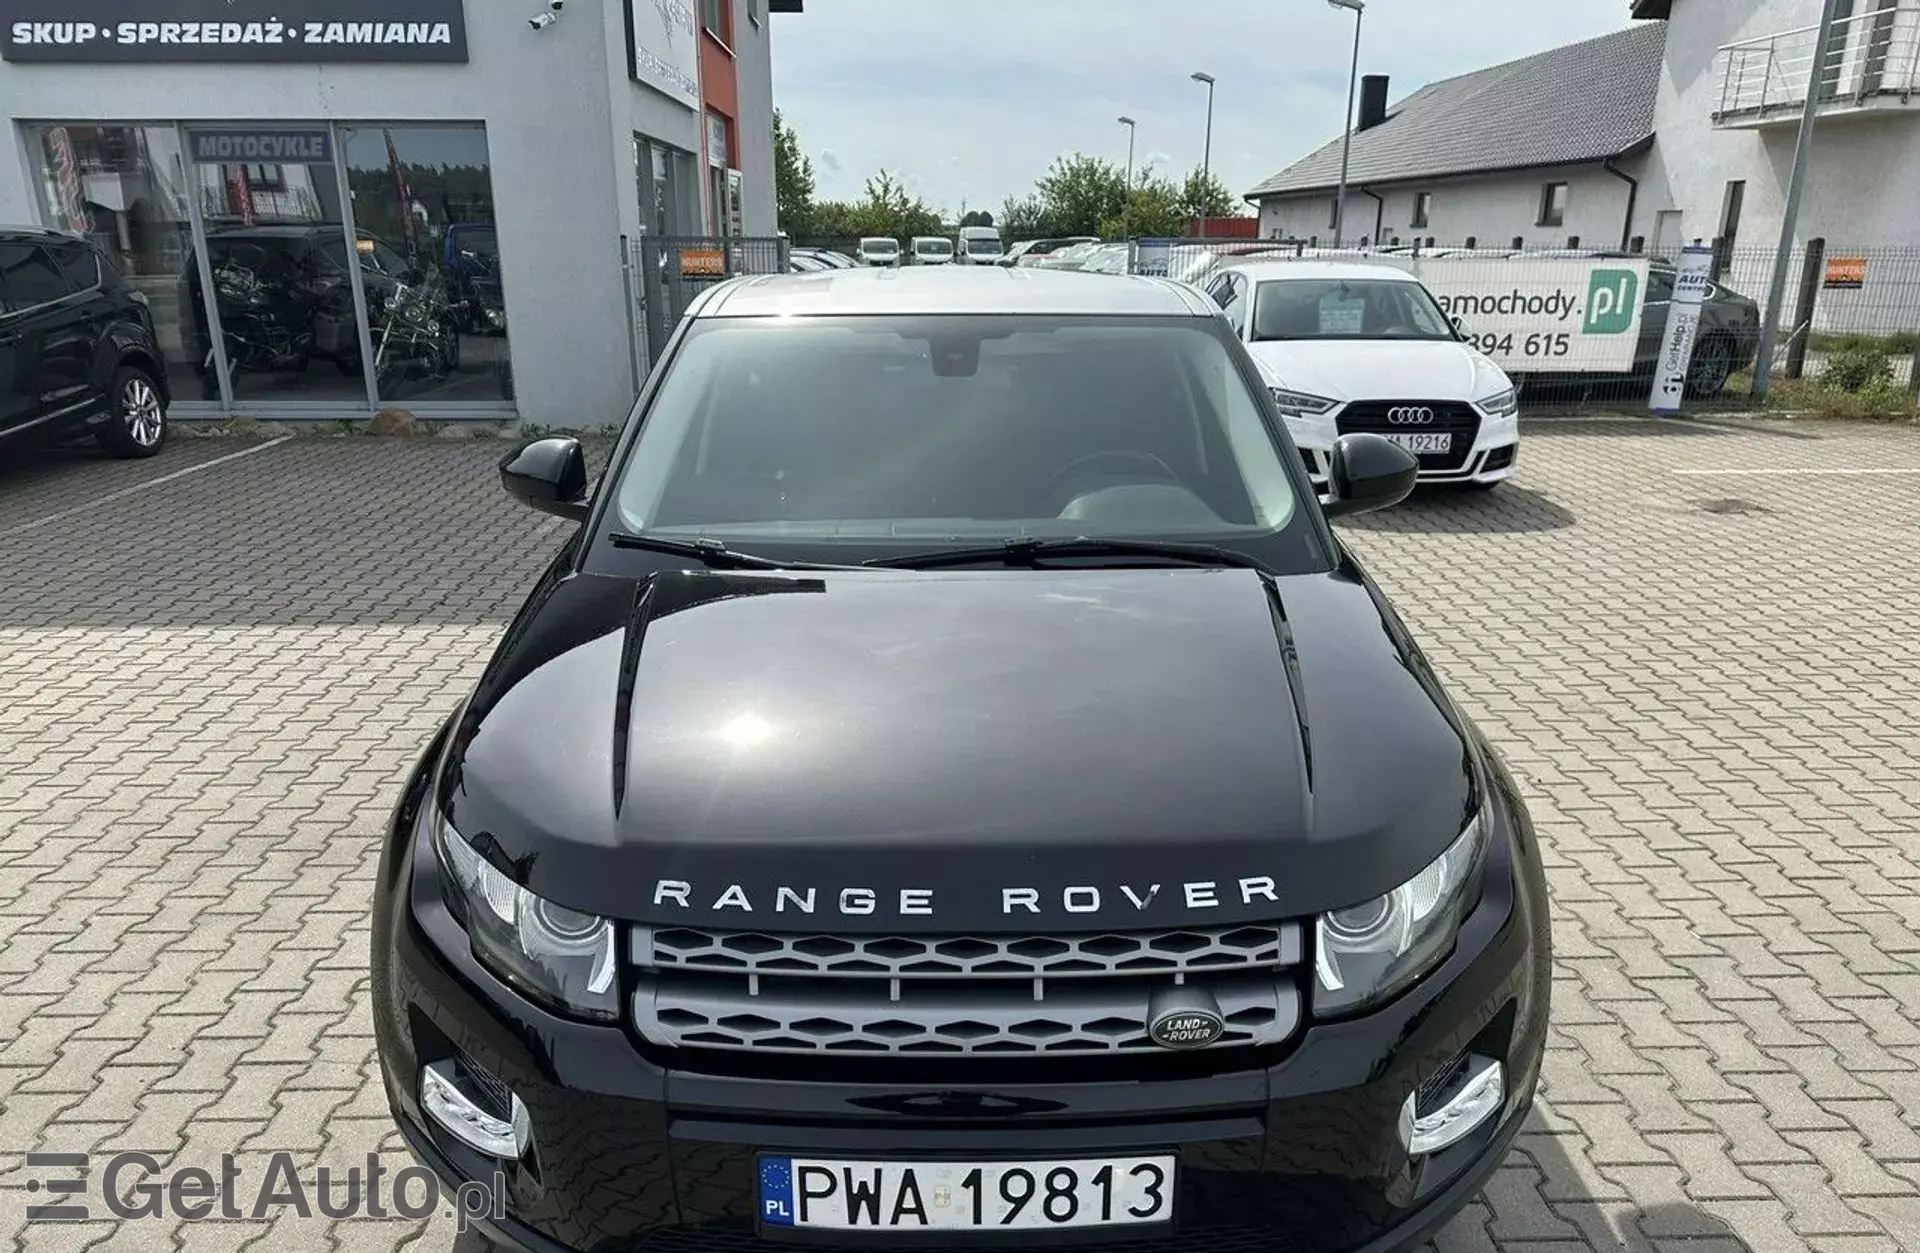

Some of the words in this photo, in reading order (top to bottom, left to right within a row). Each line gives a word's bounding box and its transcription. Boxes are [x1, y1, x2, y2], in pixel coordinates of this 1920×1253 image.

[11, 22, 96, 44] SKUP
[117, 16, 284, 44] SPRZEDAŻ
[304, 22, 451, 44] ZAMIANA
[199, 135, 323, 157] MOTOCYKLE
[1678, 274, 1706, 285] AUT
[1439, 277, 1629, 325] amochody.pl
[1524, 333, 1570, 356] 615
[1409, 435, 1449, 449] 19216
[653, 880, 933, 915] RANGE
[1002, 876, 1279, 914] ROVER
[798, 1165, 929, 1226] PWA
[961, 1162, 1164, 1226] 19813
[766, 1201, 790, 1217] PL
